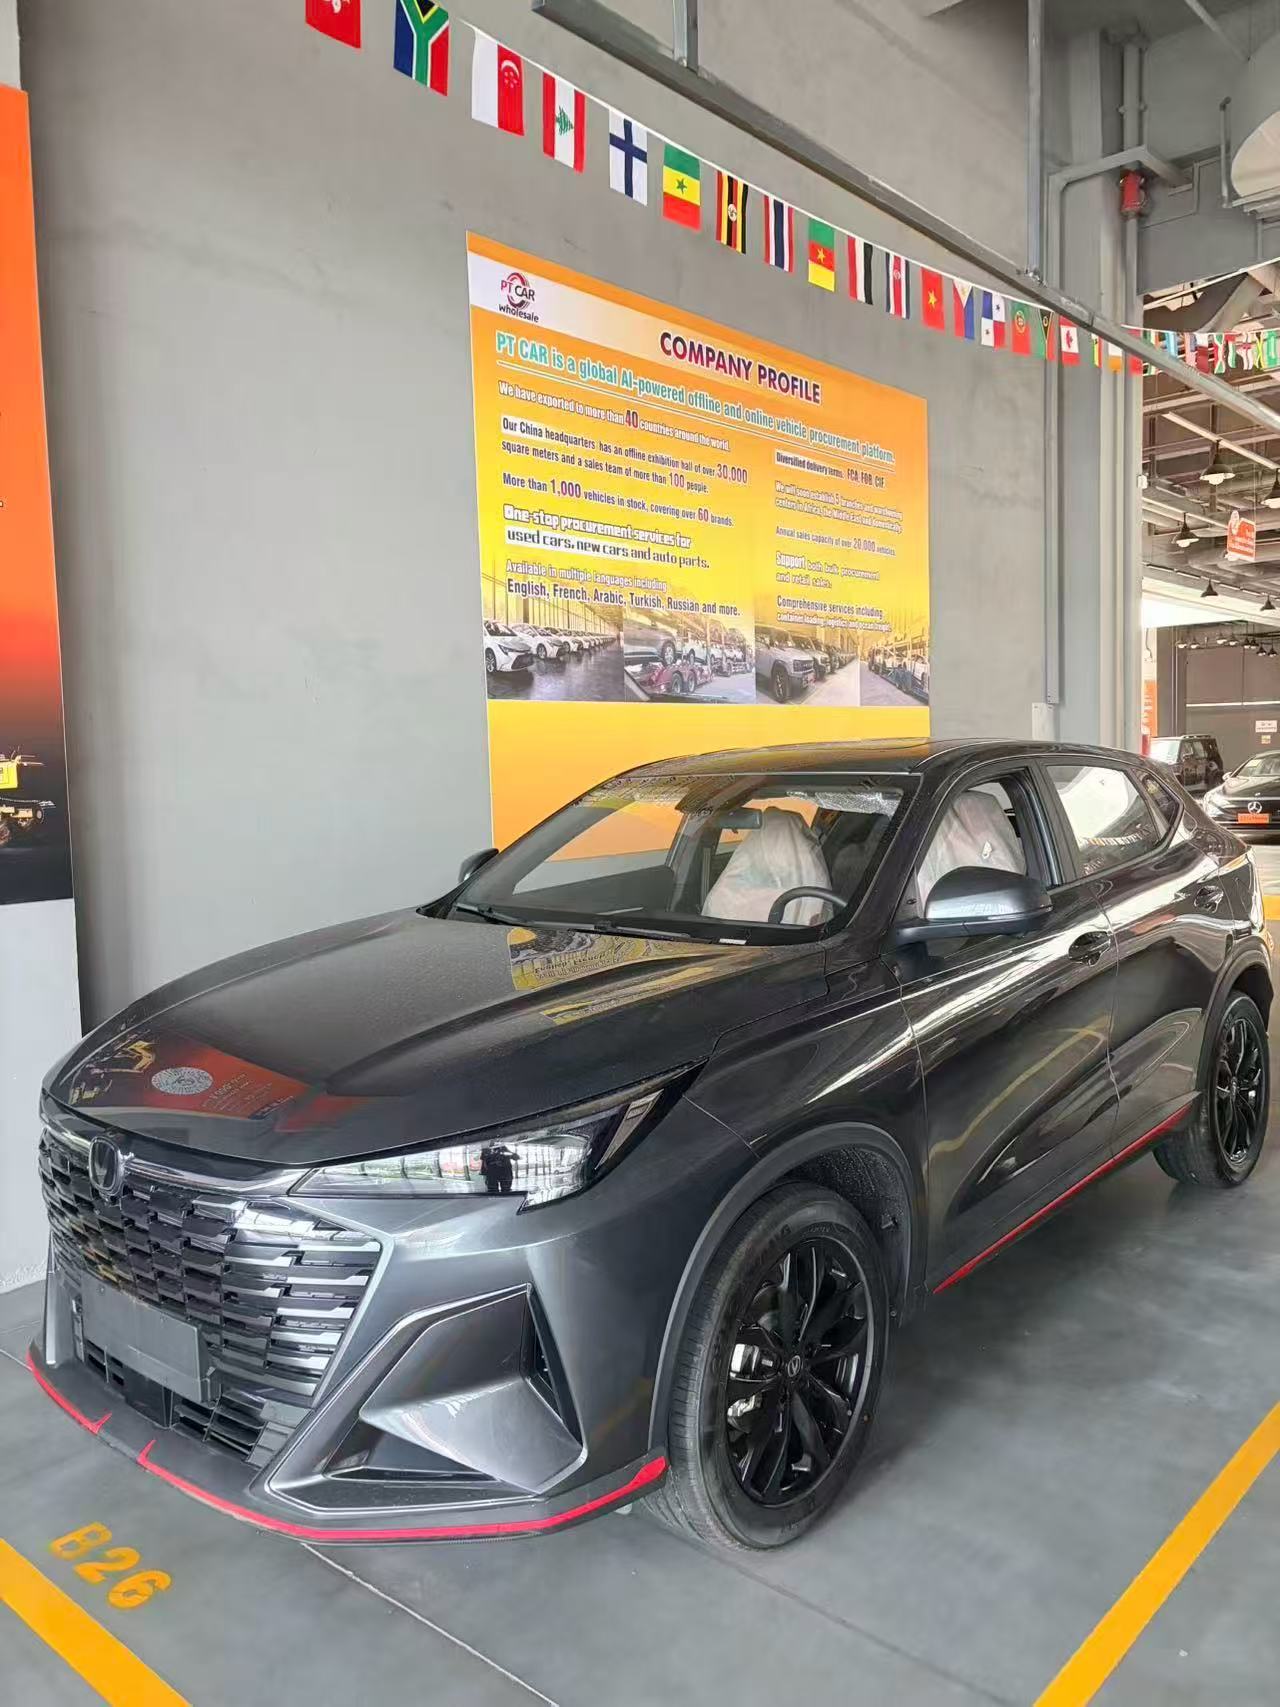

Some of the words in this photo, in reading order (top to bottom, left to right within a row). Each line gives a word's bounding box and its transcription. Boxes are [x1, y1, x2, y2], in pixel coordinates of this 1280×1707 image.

[500, 280, 513, 293] PT
[514, 285, 535, 301] CAR
[498, 303, 539, 323] wholesale
[660, 332, 753, 381] COMPANY
[757, 364, 820, 404] PROFILE
[496, 331, 515, 355] PT
[518, 338, 549, 365] CAR
[551, 348, 564, 369] is
[567, 357, 576, 373] a
[579, 359, 618, 385] global
[621, 369, 685, 403] AI-powered
[688, 391, 721, 414] offline
[724, 403, 742, 419] and
[745, 407, 774, 429] online
[775, 418, 807, 438] vehicle
[809, 428, 860, 454] procurement
[861, 442, 895, 463] platform.
[499, 381, 513, 396] We
[515, 385, 536, 402] have
[538, 393, 575, 412] exported
[576, 402, 584, 414] to
[585, 405, 606, 420] more
[606, 410, 625, 425] than
[625, 409, 639, 429] 40
[640, 419, 674, 438] countries
[674, 428, 699, 444] around
[699, 433, 711, 446] the
[503, 417, 517, 432] Our
[519, 421, 543, 438] China
[545, 428, 596, 449] headquarters
[600, 442, 612, 453] has
[614, 445, 623, 456] an
[625, 448, 646, 460] offline
[648, 453, 680, 469] exhibition
[681, 459, 693, 471] hall
[694, 464, 701, 473] of
[702, 466, 715, 476] over
[776, 451, 805, 469] Diversified
[501, 440, 530, 455] square
[532, 448, 559, 461] meters
[561, 454, 575, 465] and
[578, 457, 583, 466] a
[584, 459, 604, 471] sales
[605, 462, 623, 475] team
[625, 467, 632, 477] of
[633, 470, 650, 481] more
[652, 472, 667, 485] than
[669, 472, 685, 488] 100
[686, 481, 709, 494] people.
[503, 472, 525, 488] More
[528, 478, 547, 492] than
[550, 479, 582, 499] 1,000
[583, 490, 615, 505] vehicles
[617, 495, 625, 506] in
[626, 498, 649, 512] stock,
[650, 503, 680, 519] covering
[681, 511, 696, 520] over
[697, 508, 709, 522] 60
[711, 515, 734, 526] brands.
[503, 503, 560, 531] One-stop
[560, 516, 633, 540] procurement
[632, 529, 676, 547] services
[675, 532, 692, 549] for
[776, 526, 795, 537] Annual
[796, 530, 811, 541] sales
[811, 534, 834, 546] capacity
[834, 538, 841, 546] of
[507, 529, 541, 544] used
[576, 541, 601, 553] new
[602, 544, 629, 558] cars
[630, 547, 651, 561] and
[652, 551, 678, 564] auto
[679, 555, 710, 569] parts.
[776, 550, 806, 570] Support
[807, 559, 823, 573] both
[824, 562, 839, 575] bulk
[841, 567, 880, 581] procurement
[506, 558, 547, 577] Available
[548, 563, 557, 577] in
[559, 567, 592, 583] multiple
[593, 571, 632, 588] languages
[633, 576, 668, 593] including
[776, 572, 790, 583] and
[791, 574, 811, 586] retail
[507, 578, 550, 600] English,
[667, 597, 700, 612] Russian
[702, 603, 717, 614] and
[718, 606, 741, 616] more.
[777, 595, 828, 611] Comprehensive
[829, 603, 855, 615] services
[855, 605, 883, 620] including
[49, 1521, 172, 1609] B26
